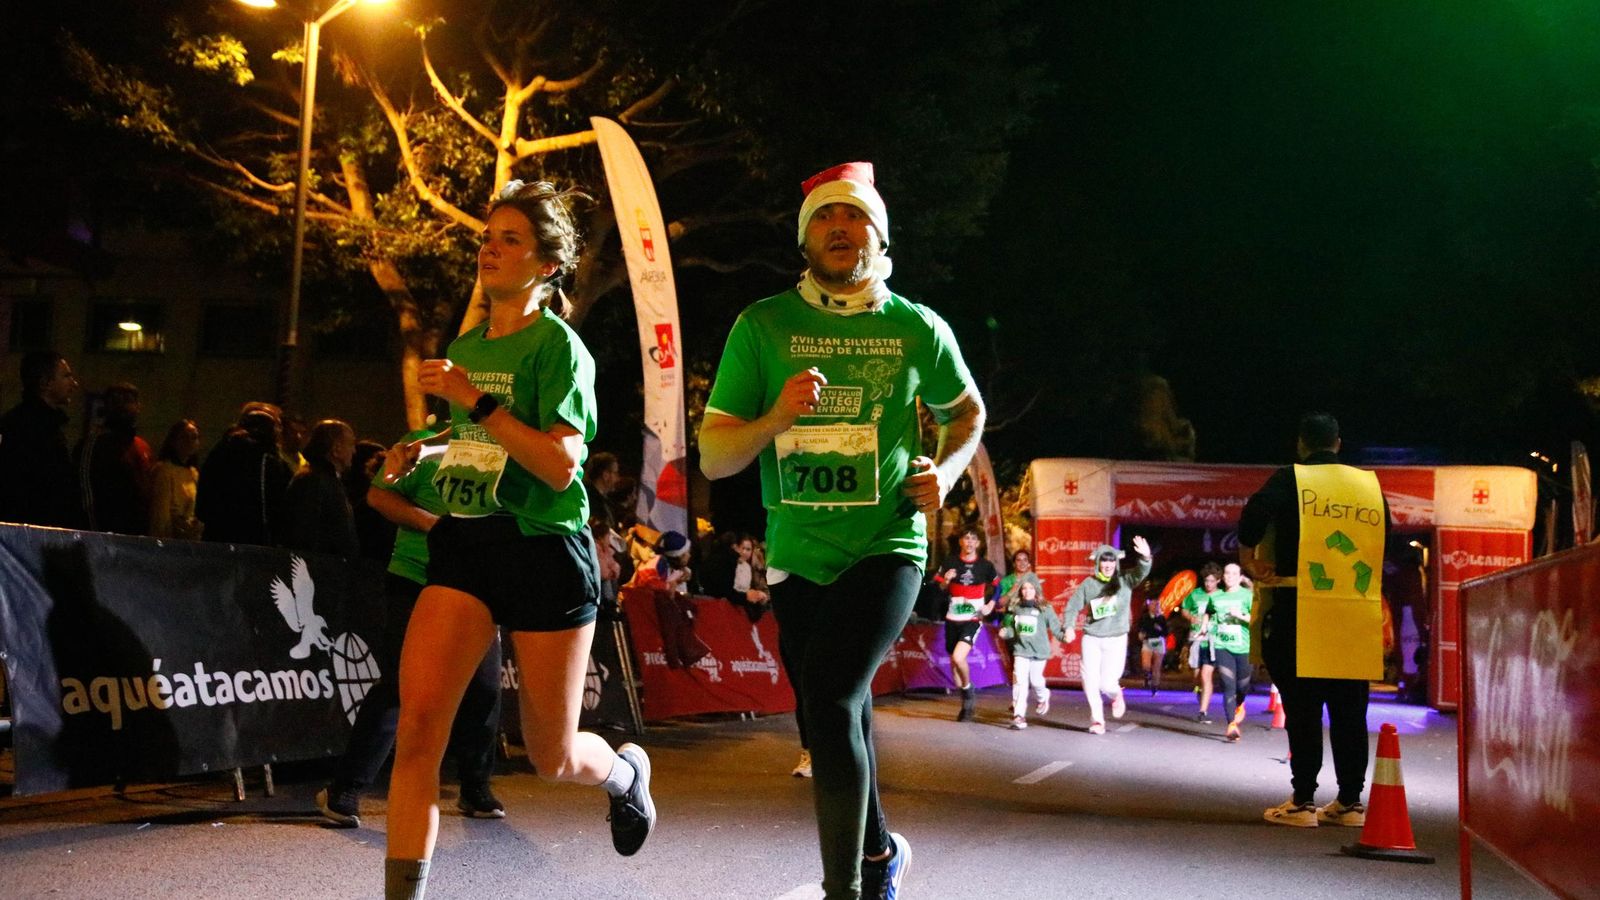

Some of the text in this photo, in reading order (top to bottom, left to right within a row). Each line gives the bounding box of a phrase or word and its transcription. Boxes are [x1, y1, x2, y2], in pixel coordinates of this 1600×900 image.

[791, 335, 903, 347] XVII SAN SILVESTRE
[790, 345, 904, 357] CIUDAD DE ALMERÍA
[471, 372, 515, 384] SILVESTRE
[819, 396, 860, 406] OTEGE
[816, 405, 859, 414] ENTORNO
[793, 465, 858, 493] 708
[436, 475, 489, 508] 1751
[62, 658, 335, 730] aquéatacamos
